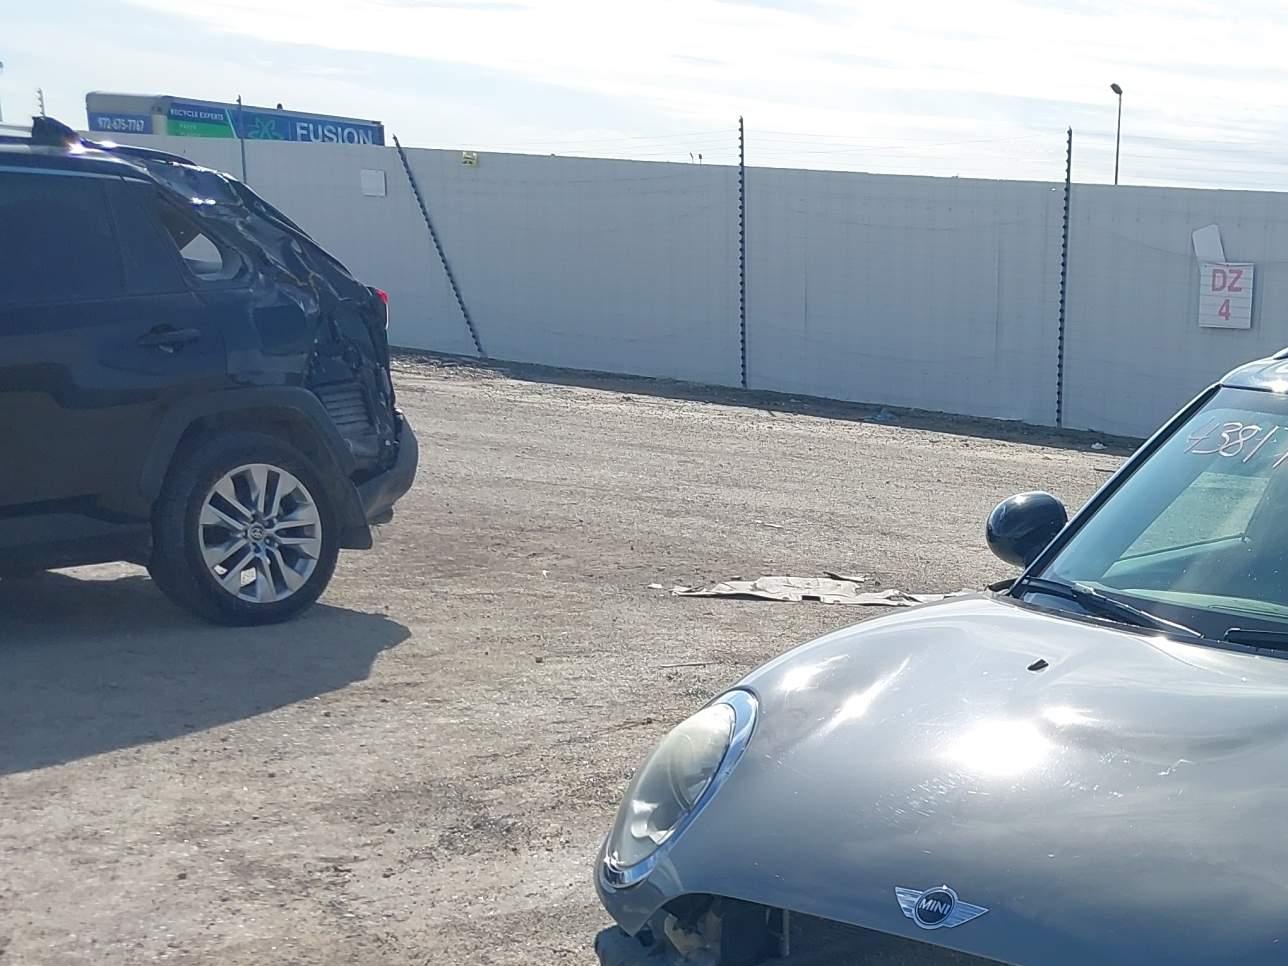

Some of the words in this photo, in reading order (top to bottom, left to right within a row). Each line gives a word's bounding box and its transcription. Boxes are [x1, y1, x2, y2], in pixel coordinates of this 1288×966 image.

[296, 122, 373, 144] FUSION
[1211, 268, 1243, 292] DZ
[1218, 299, 1231, 321] 4
[919, 898, 951, 915] MINI
